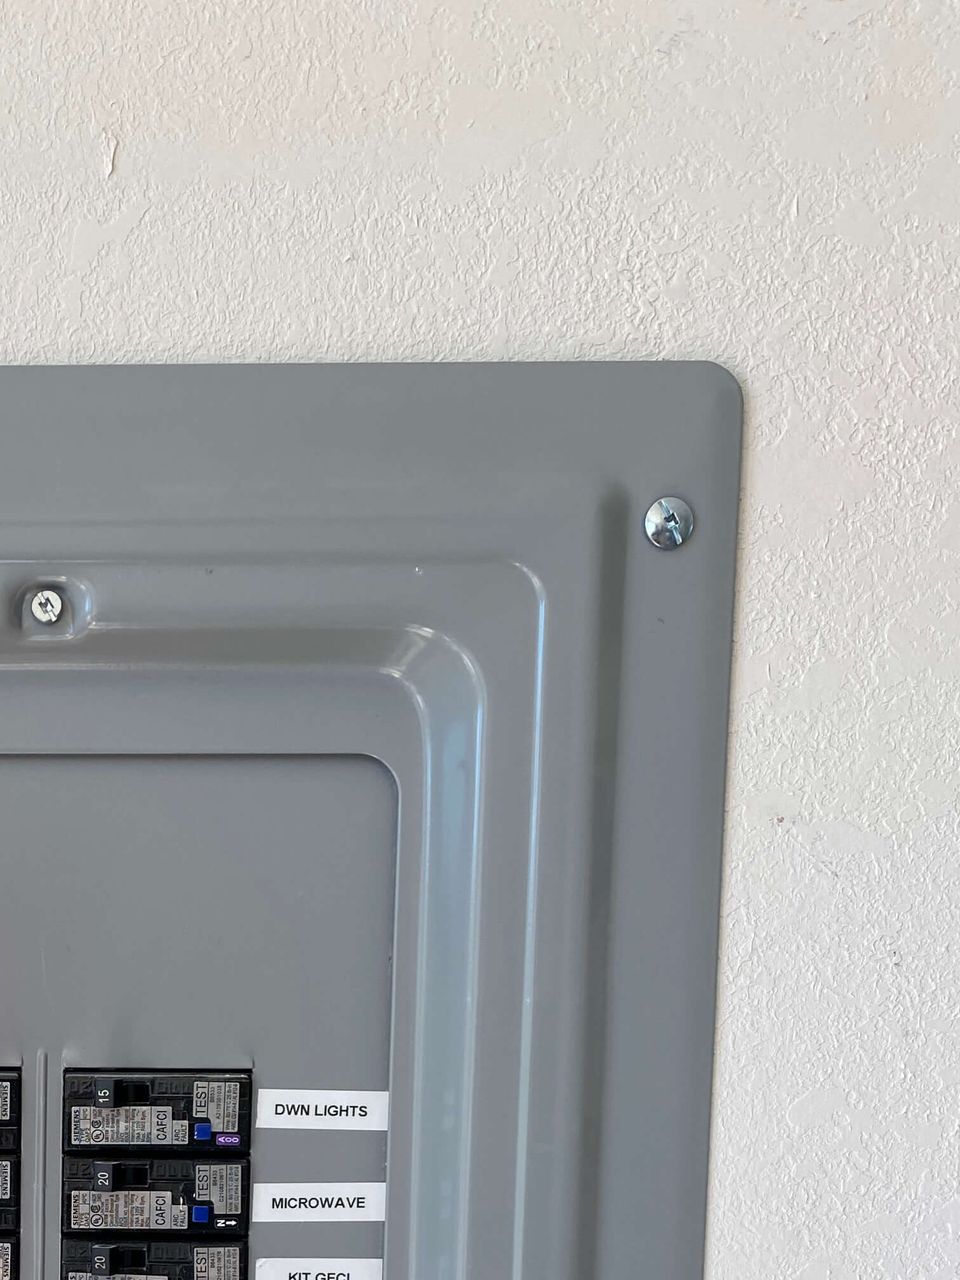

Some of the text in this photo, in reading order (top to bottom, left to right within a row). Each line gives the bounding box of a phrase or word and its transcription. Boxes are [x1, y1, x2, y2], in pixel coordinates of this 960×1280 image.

[98, 1089, 109, 1102] 15
[196, 1083, 207, 1116] TEST
[275, 1104, 368, 1117] DWN LIGHTS
[157, 1110, 167, 1140] CAFCI
[98, 1172, 109, 1185] 20
[198, 1167, 209, 1198] TEST
[156, 1196, 166, 1225] CAFCI
[272, 1197, 365, 1209] MICROWAVE
[95, 1256, 105, 1269] 20
[196, 1250, 206, 1280] TEST
